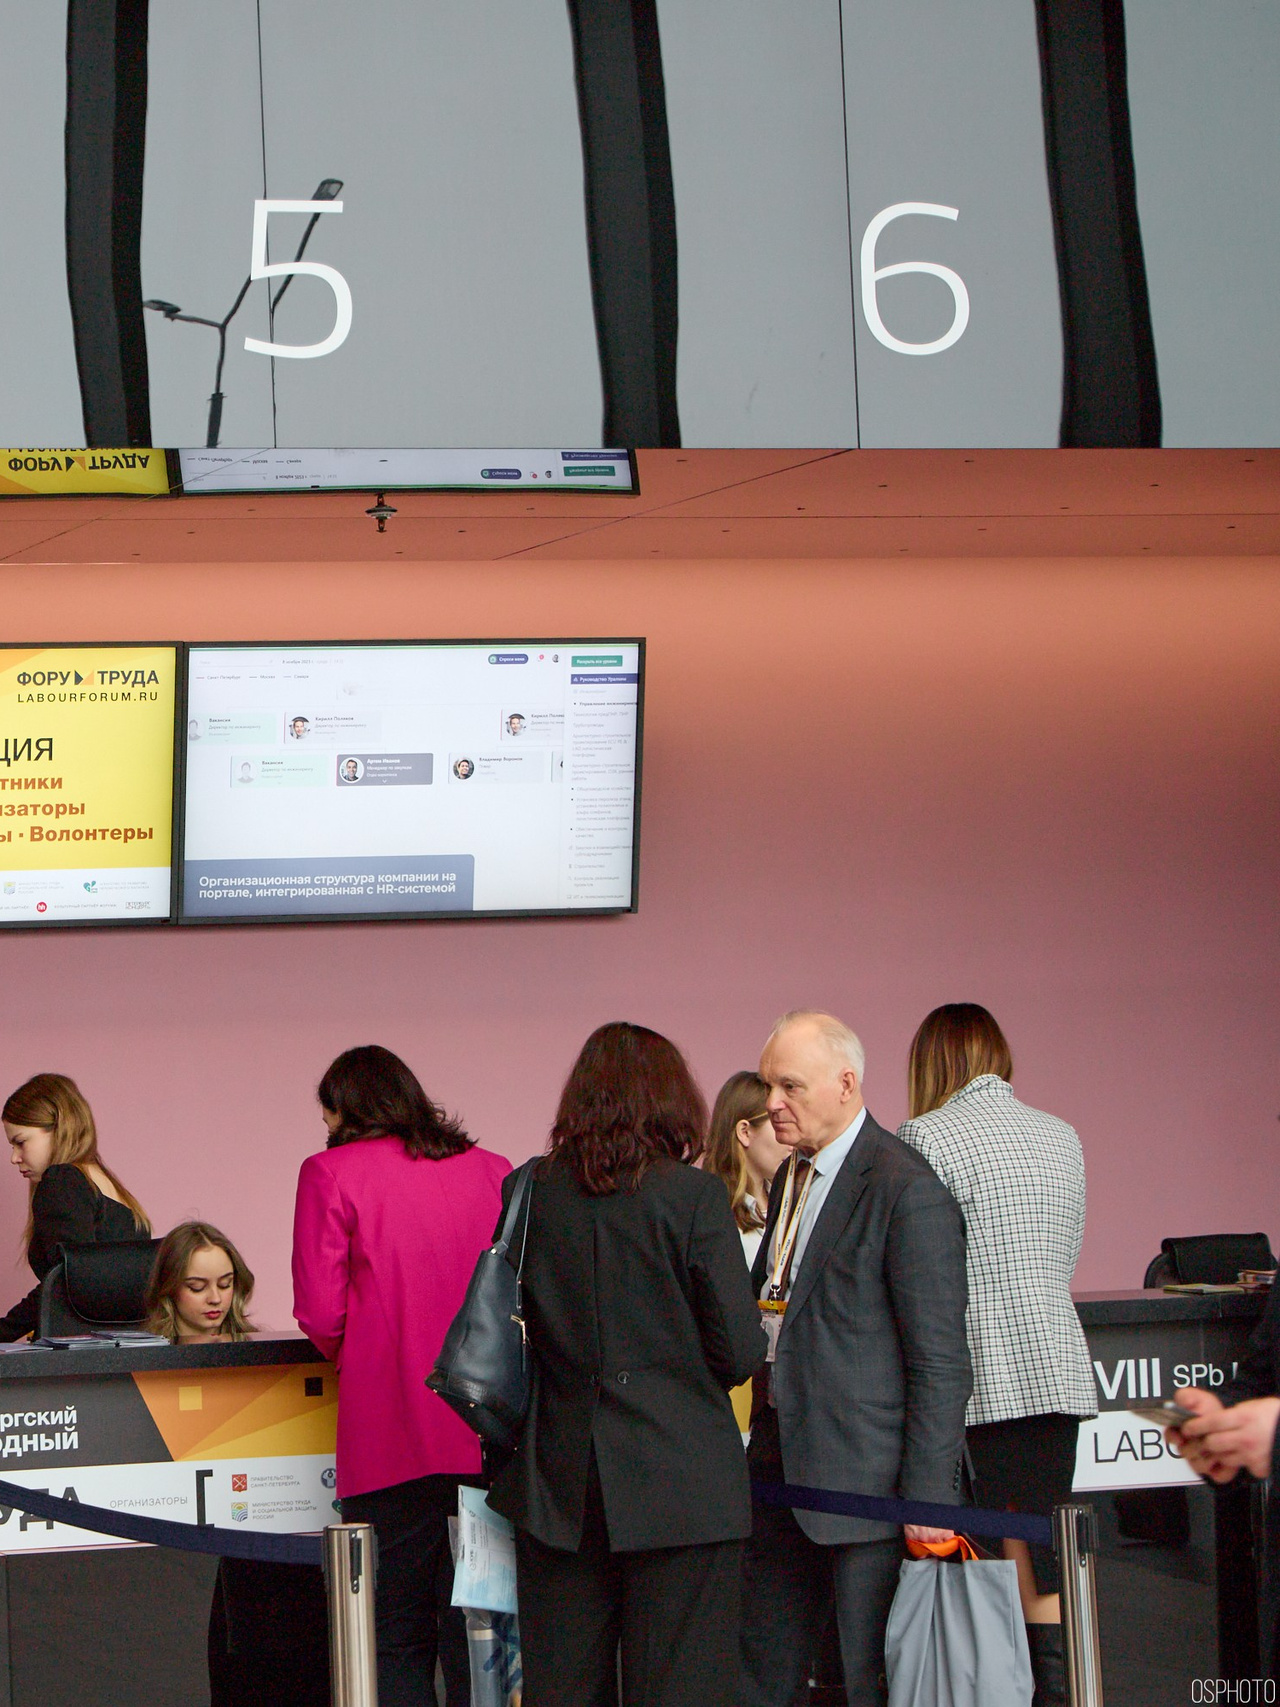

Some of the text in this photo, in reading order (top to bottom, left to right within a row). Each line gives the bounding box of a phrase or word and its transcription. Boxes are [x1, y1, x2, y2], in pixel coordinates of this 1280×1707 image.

[244, 200, 352, 359] 5
[860, 202, 970, 355] 6
[16, 670, 160, 688] ФОРУ ТРУДА
[17, 691, 159, 704] LABOURFORUM.RU
[29, 825, 154, 844] Волонтеры
[199, 871, 457, 890] Организационная структура компании на
[199, 882, 456, 902] портале, интегрированная с HR-системой
[1093, 1358, 1225, 1400] VIII SPb
[109, 1496, 189, 1509] ОРГАНИЗАТОРЫ
